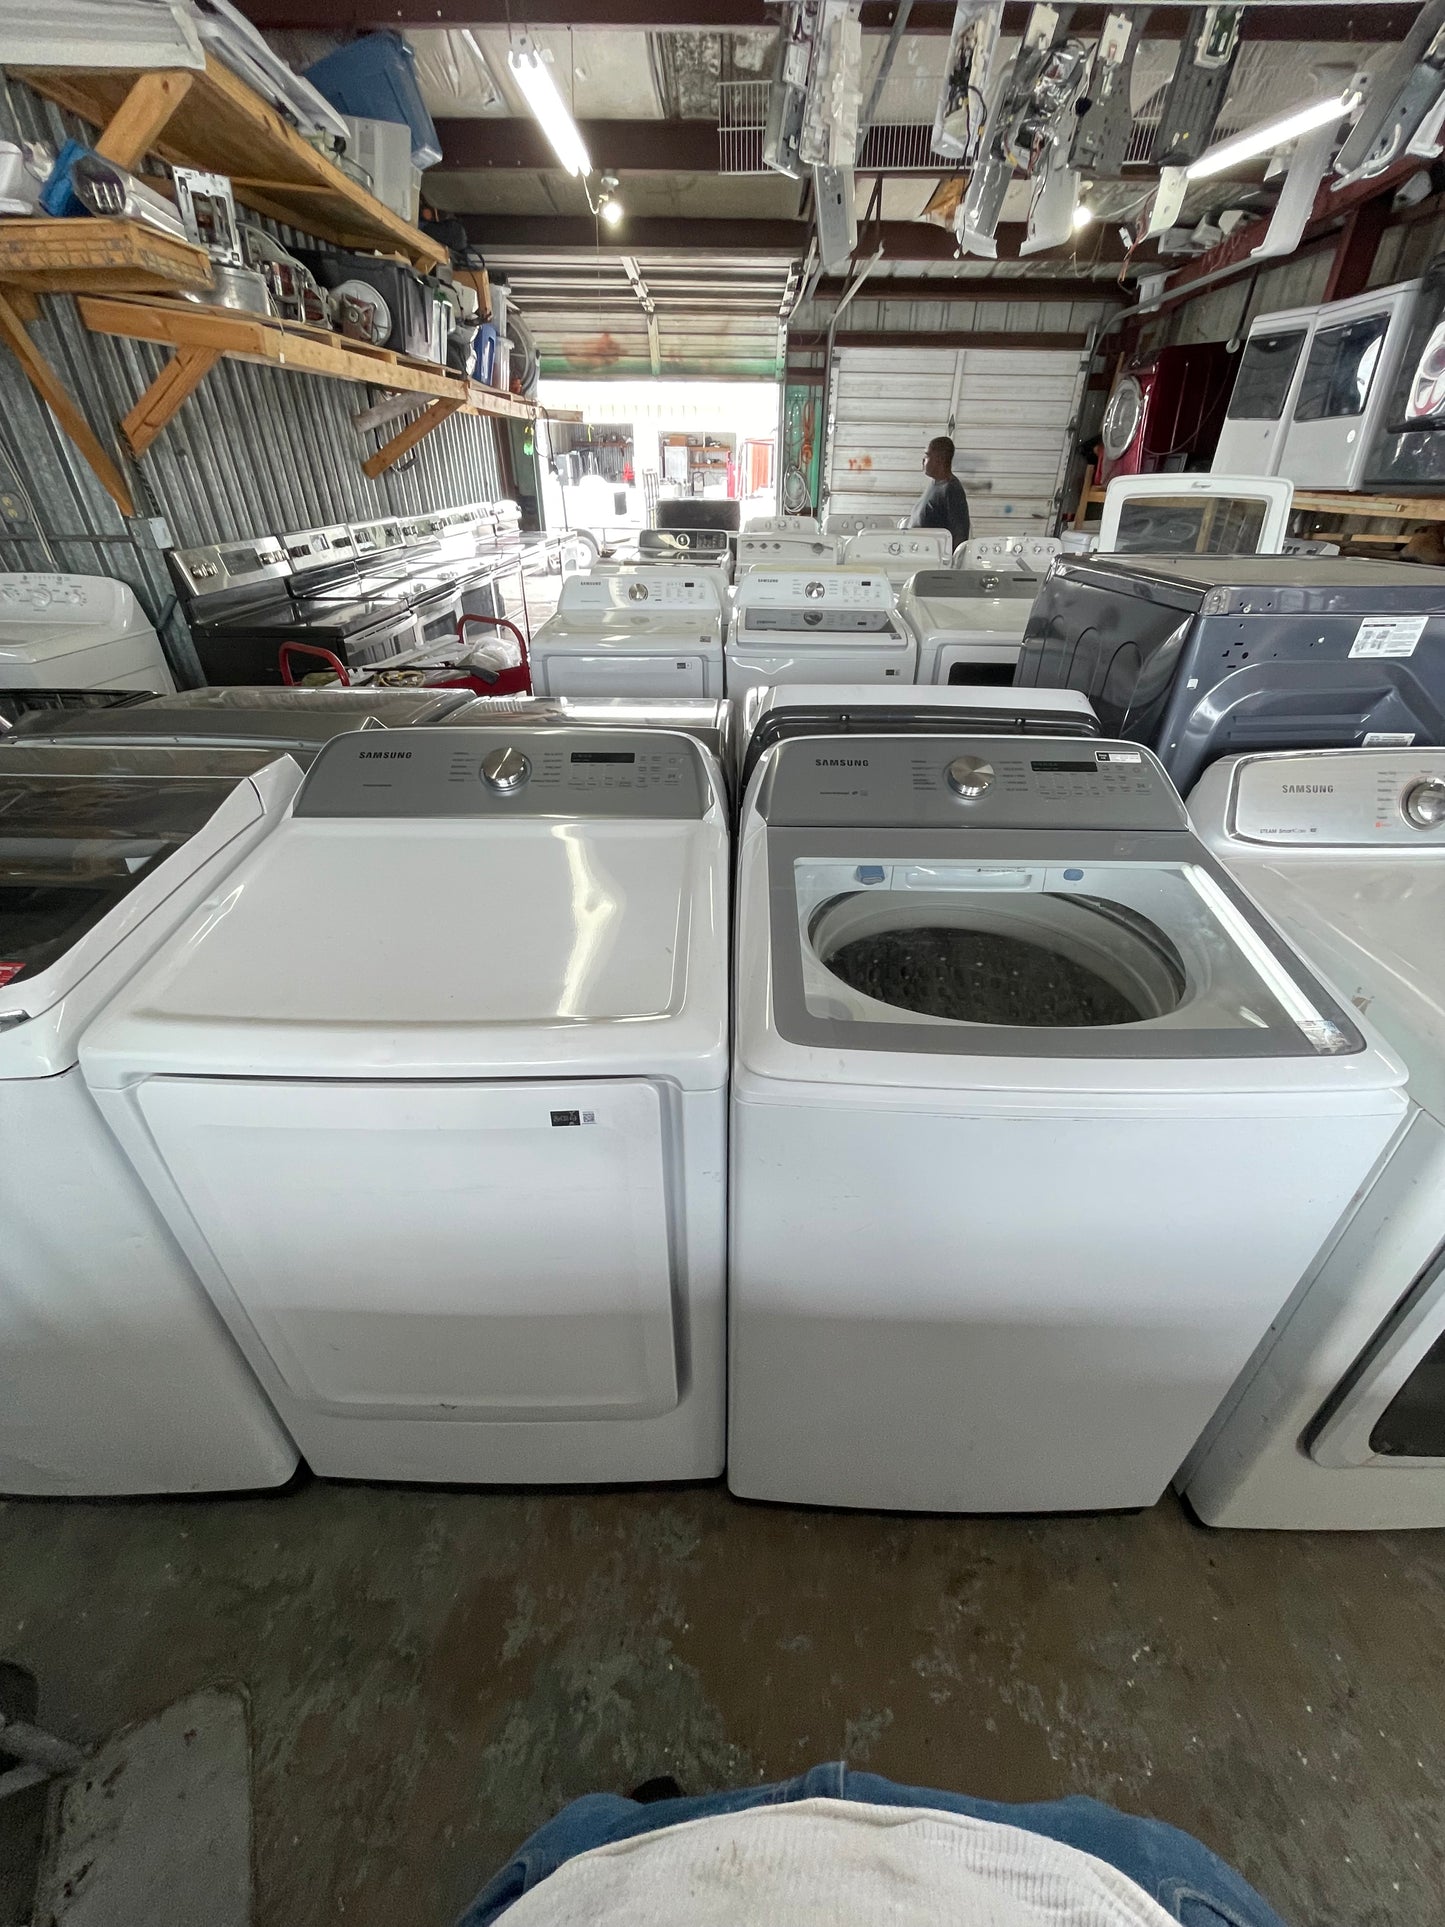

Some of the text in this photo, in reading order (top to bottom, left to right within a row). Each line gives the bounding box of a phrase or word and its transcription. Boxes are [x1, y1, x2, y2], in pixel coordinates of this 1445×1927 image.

[359, 751, 413, 759] SAMSUNG
[815, 758, 869, 767] SAMSUNG
[1282, 784, 1334, 793] SAMSUNG
